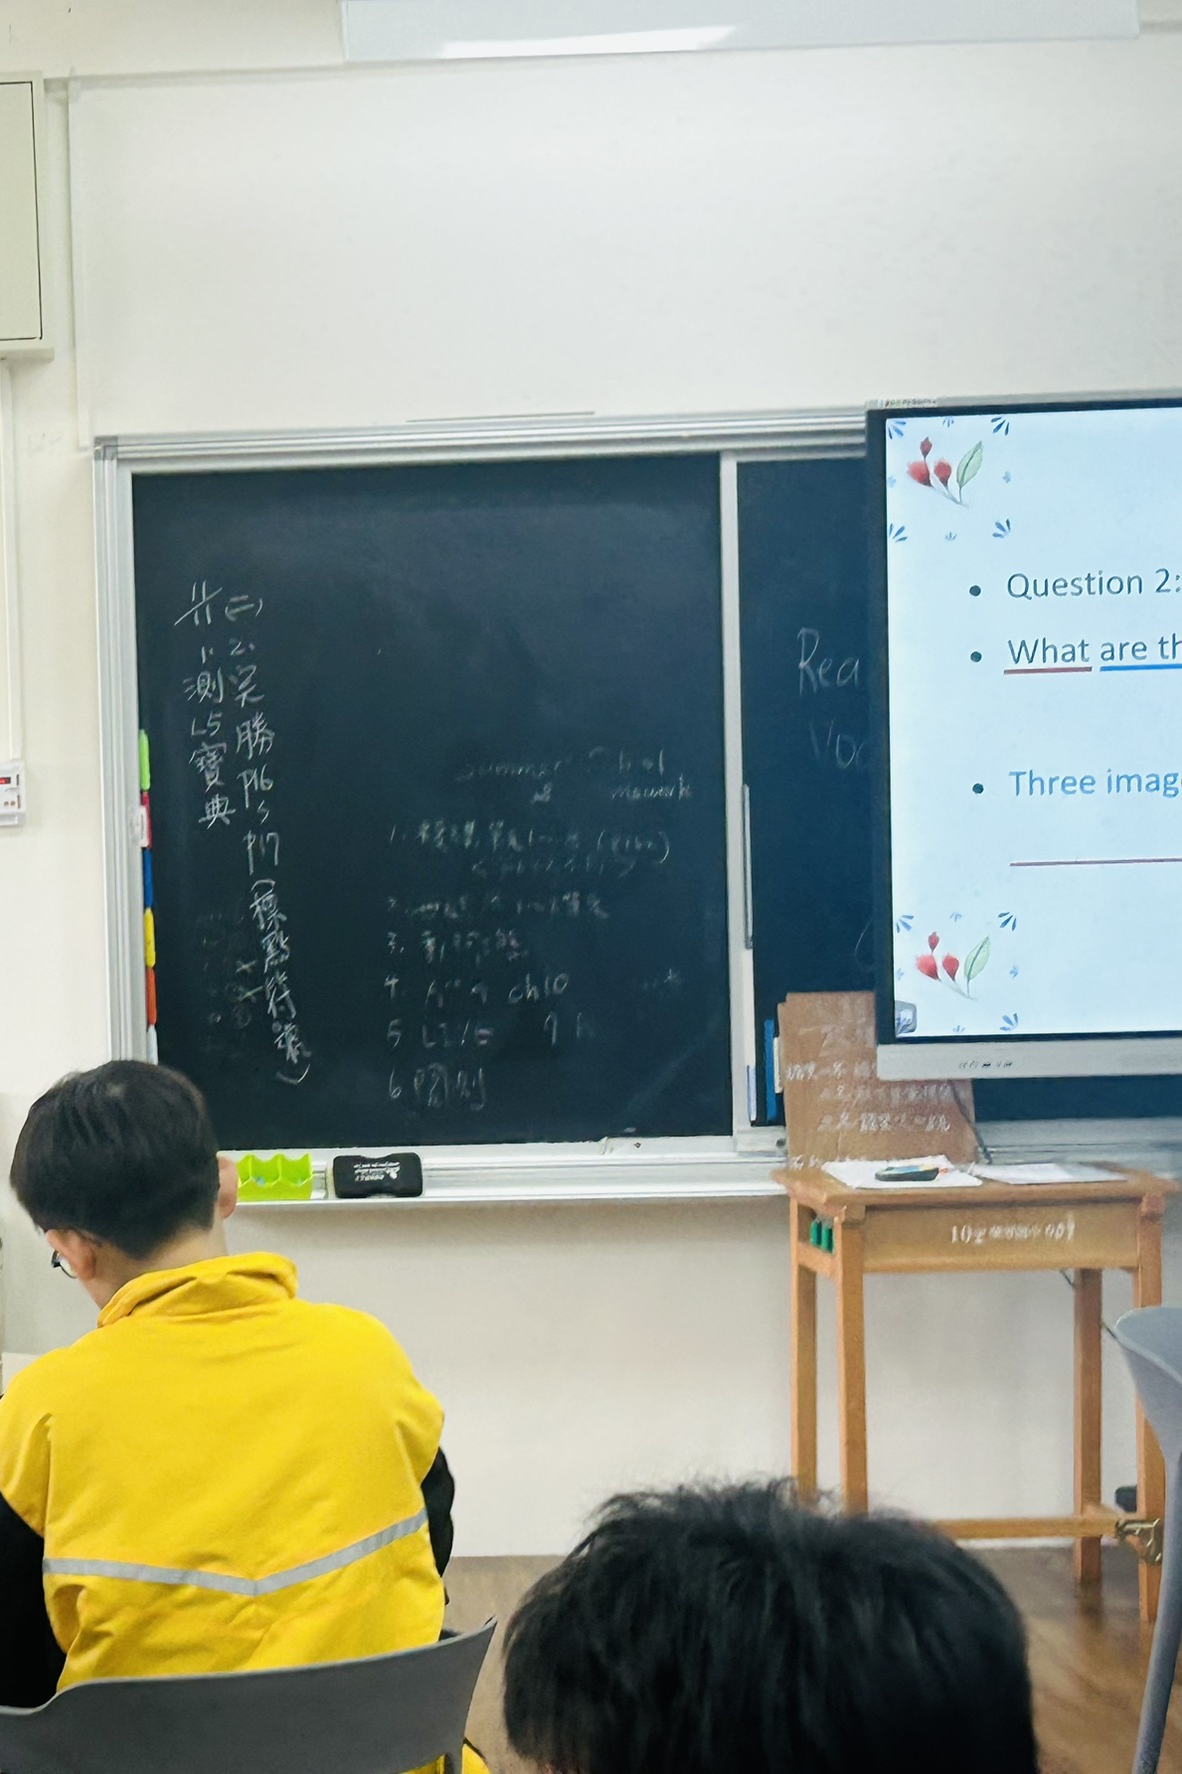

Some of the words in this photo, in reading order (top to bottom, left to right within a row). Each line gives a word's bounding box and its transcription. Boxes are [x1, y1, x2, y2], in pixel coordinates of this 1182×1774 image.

[1007, 570, 1143, 600] Question
[1155, 568, 1181, 593] 2:
[797, 627, 861, 694] Rea
[1008, 637, 1090, 664] What
[1100, 641, 1148, 661] are
[1158, 633, 1182, 660] th
[1009, 769, 1097, 796] Three
[1107, 768, 1182, 798] imag
